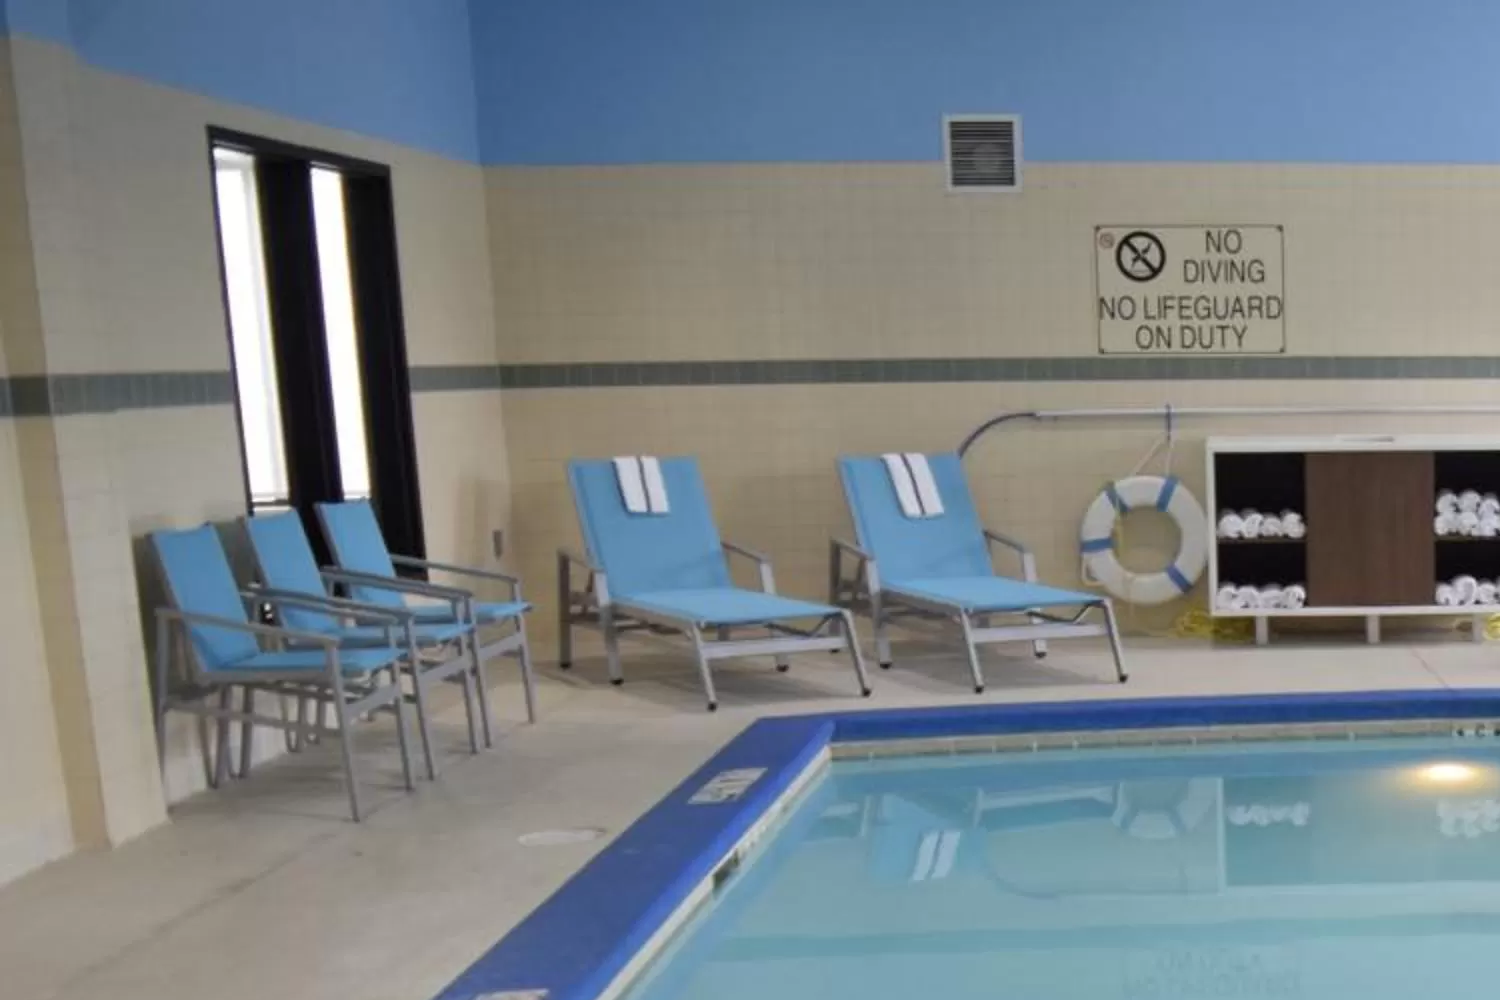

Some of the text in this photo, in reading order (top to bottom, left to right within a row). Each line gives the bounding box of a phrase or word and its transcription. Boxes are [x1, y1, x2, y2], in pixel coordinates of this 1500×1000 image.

[1205, 229, 1242, 254] NO
[1183, 259, 1265, 284] DIVING
[1099, 295, 1281, 320] NO LIFEGUARD
[1135, 324, 1248, 350] ON DUTY
